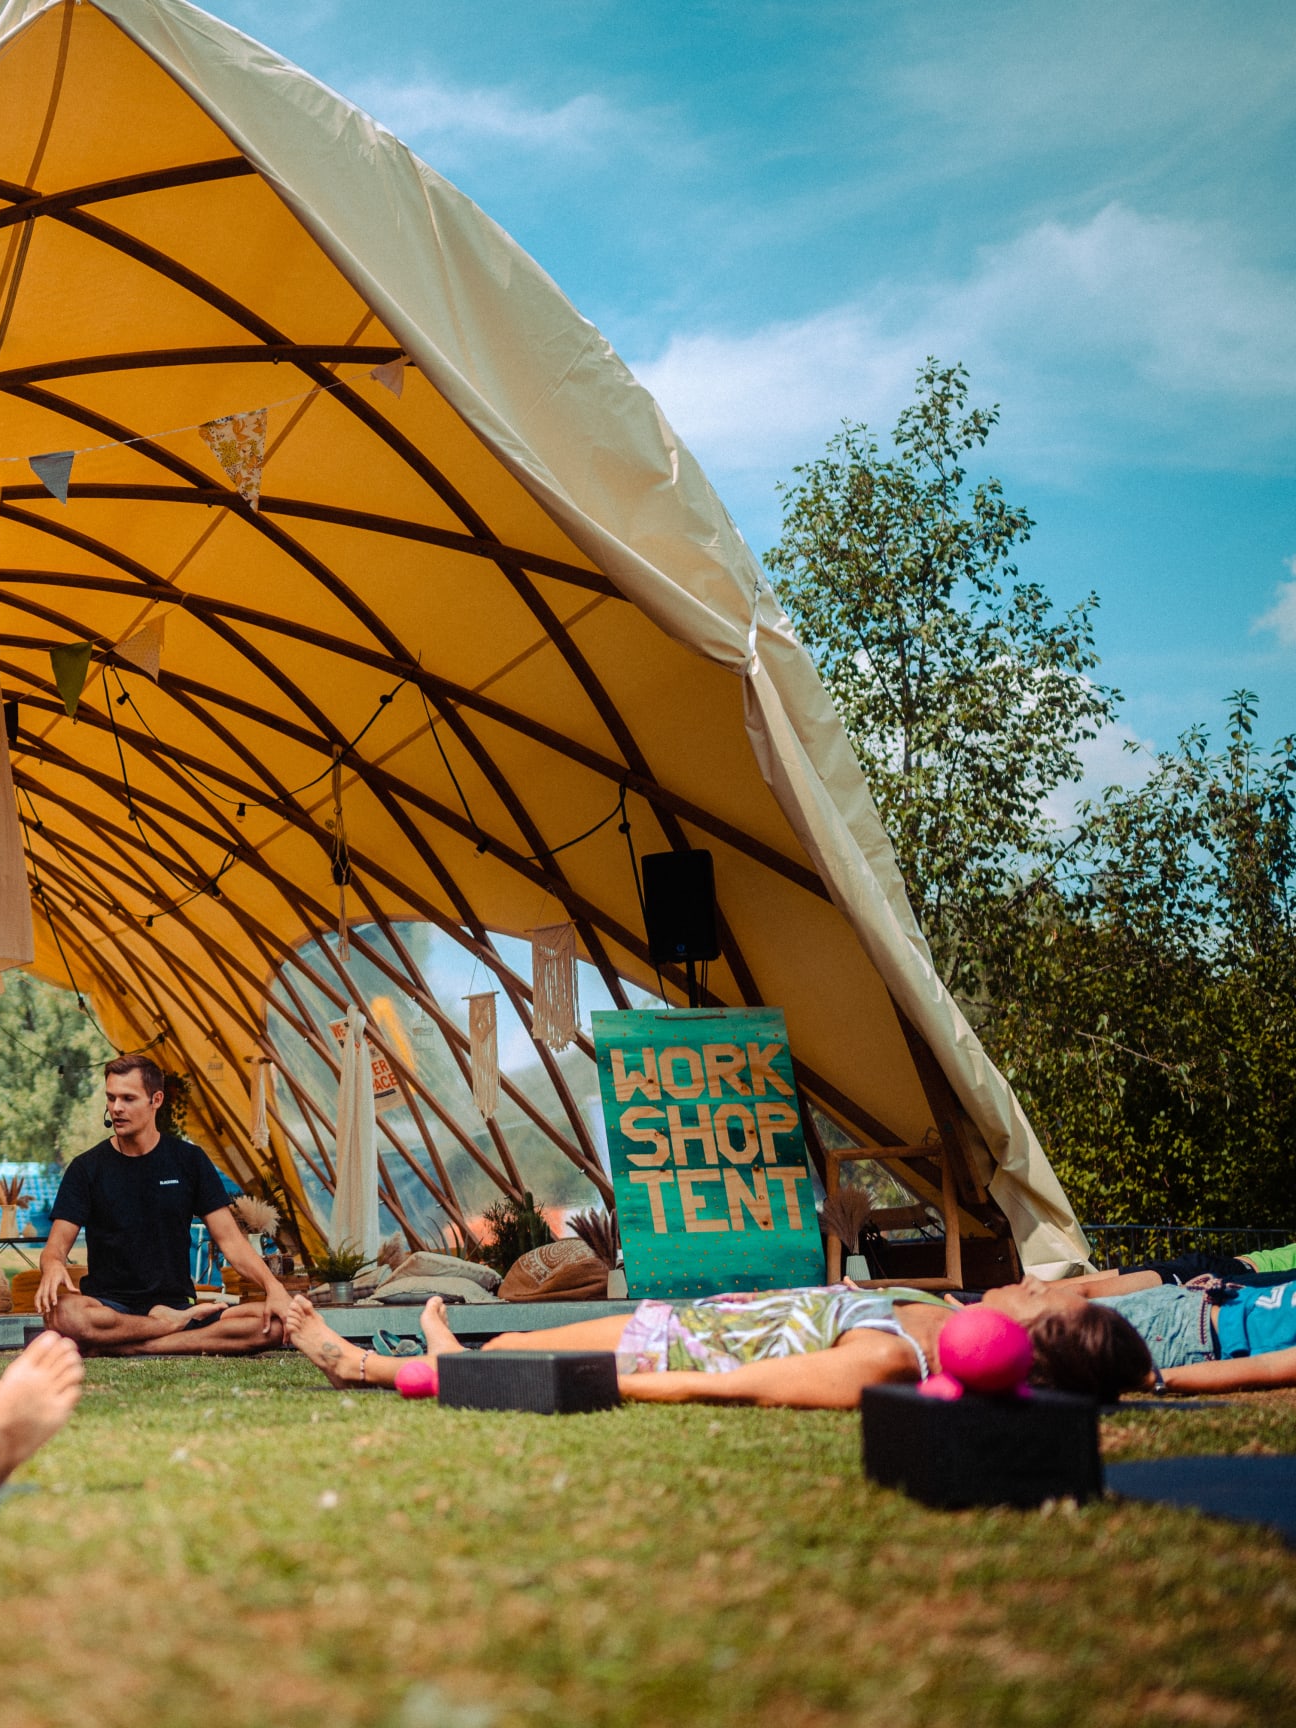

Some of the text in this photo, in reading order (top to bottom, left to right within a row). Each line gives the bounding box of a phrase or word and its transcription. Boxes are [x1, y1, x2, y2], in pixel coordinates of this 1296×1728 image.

[609, 1042, 795, 1102] WORK
[619, 1102, 799, 1167] SHOP
[629, 1166, 807, 1234] TENT
